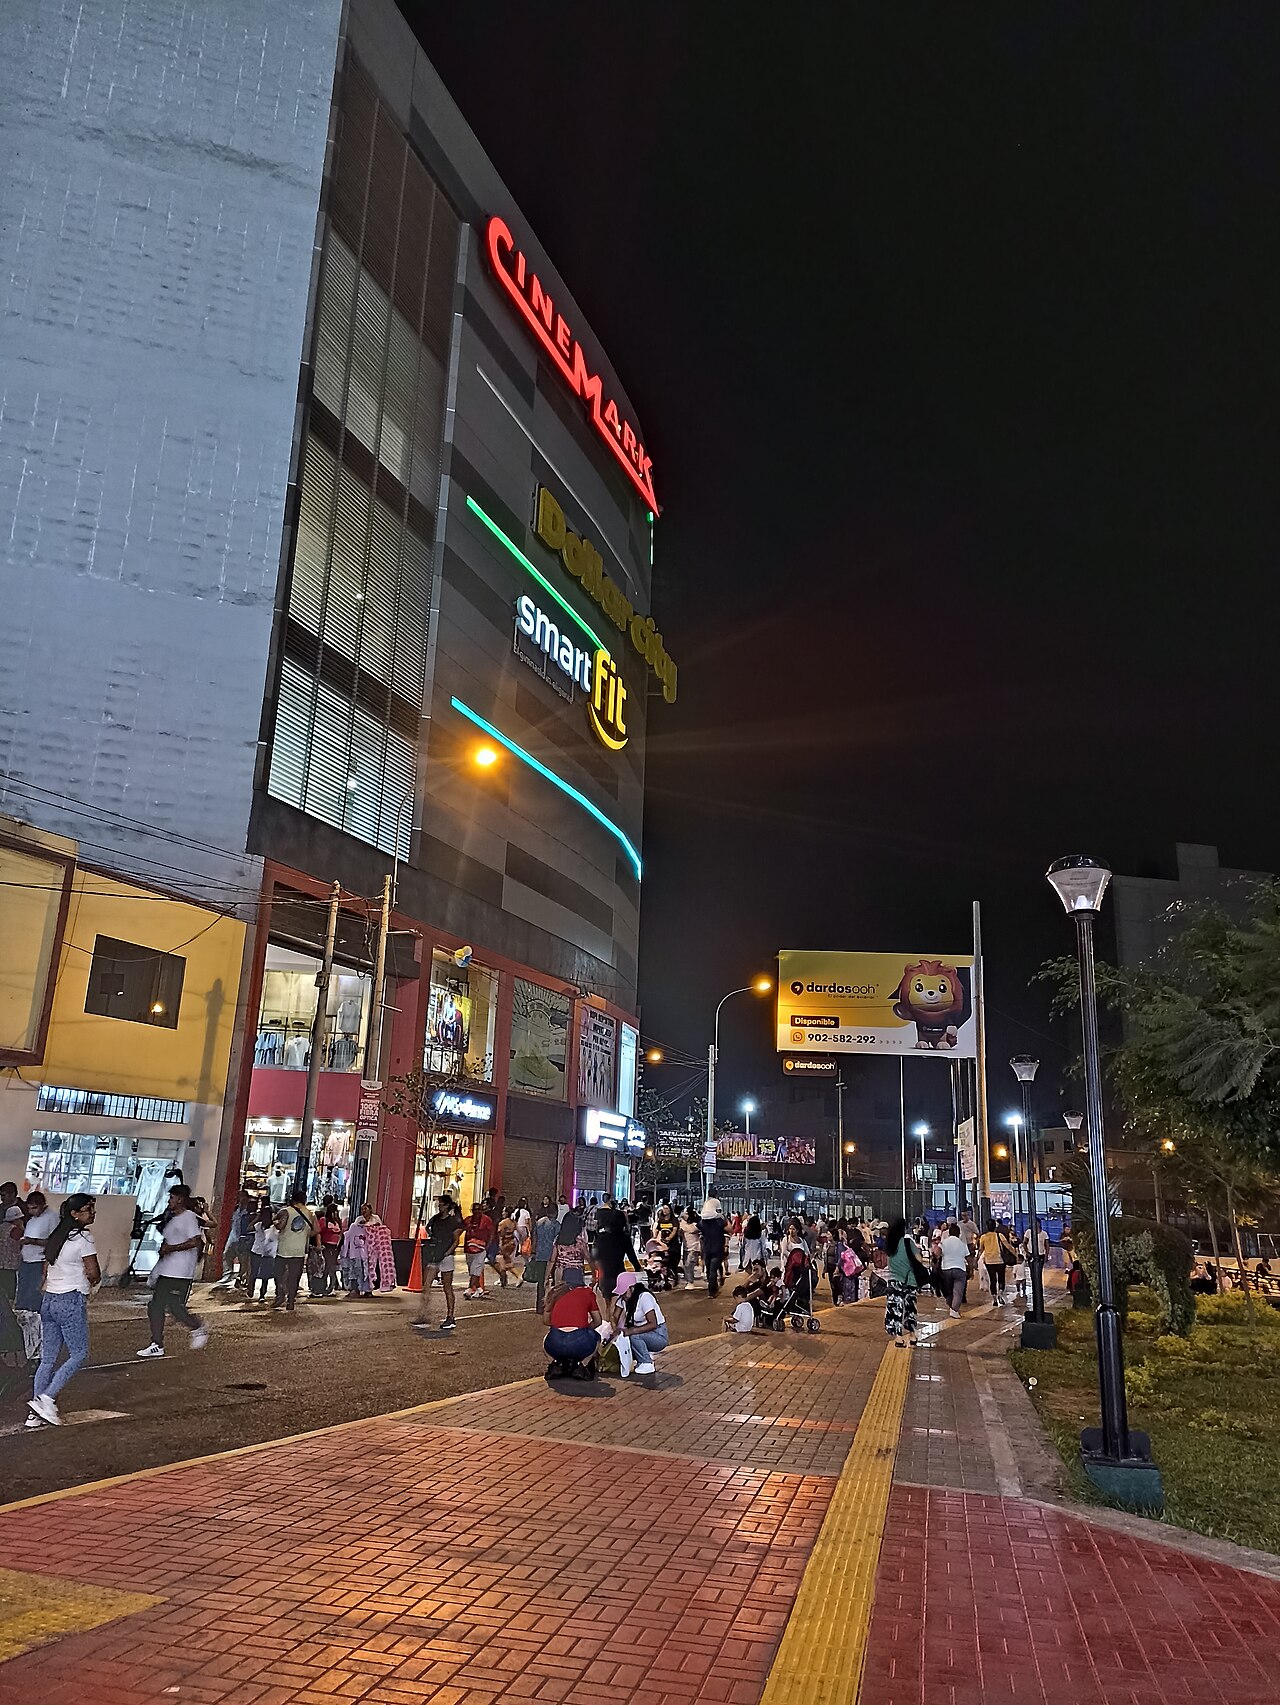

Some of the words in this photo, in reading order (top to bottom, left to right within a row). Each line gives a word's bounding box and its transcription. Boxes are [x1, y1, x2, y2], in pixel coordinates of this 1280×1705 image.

[486, 217, 660, 517] CINEMARK
[516, 594, 592, 693] smart
[591, 649, 627, 735] fit
[806, 982, 876, 993] dardosooh
[794, 1017, 836, 1027] Disponible
[807, 1033, 876, 1044] 902-582-292
